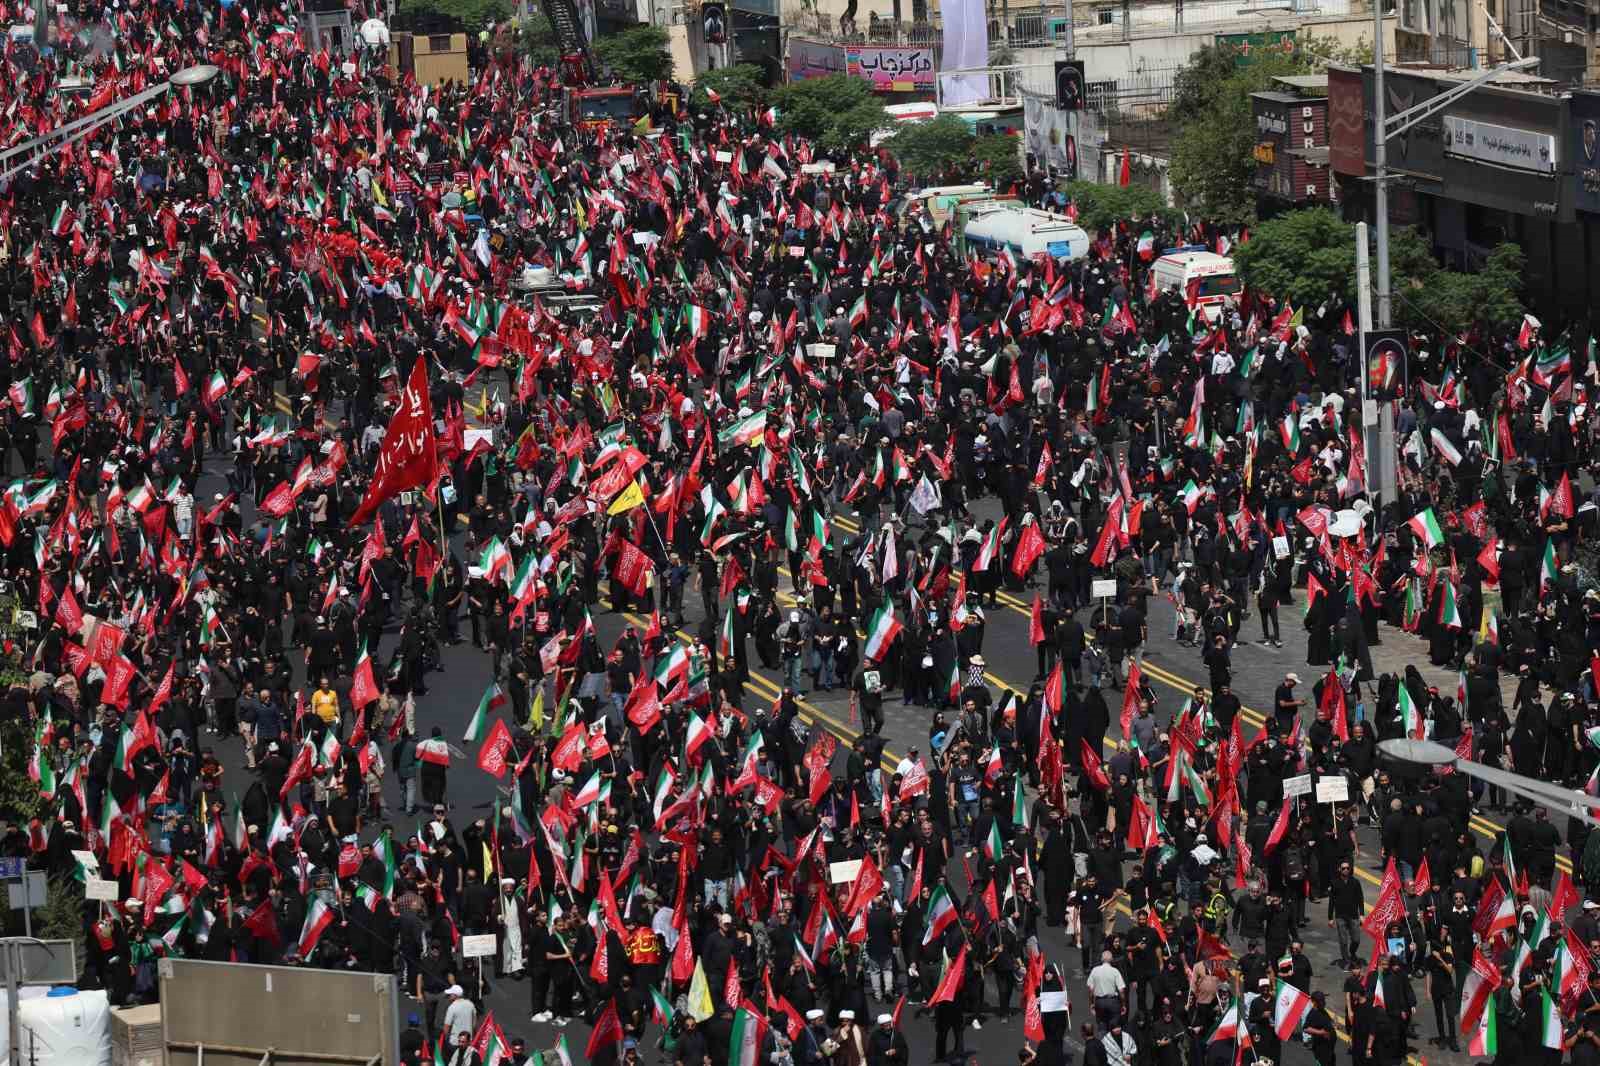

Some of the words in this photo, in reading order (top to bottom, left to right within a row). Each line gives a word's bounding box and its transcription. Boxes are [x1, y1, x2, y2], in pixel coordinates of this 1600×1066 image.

[859, 51, 898, 80] چاپ
[897, 52, 931, 76] مرکز
[1302, 106, 1317, 196] BURR
